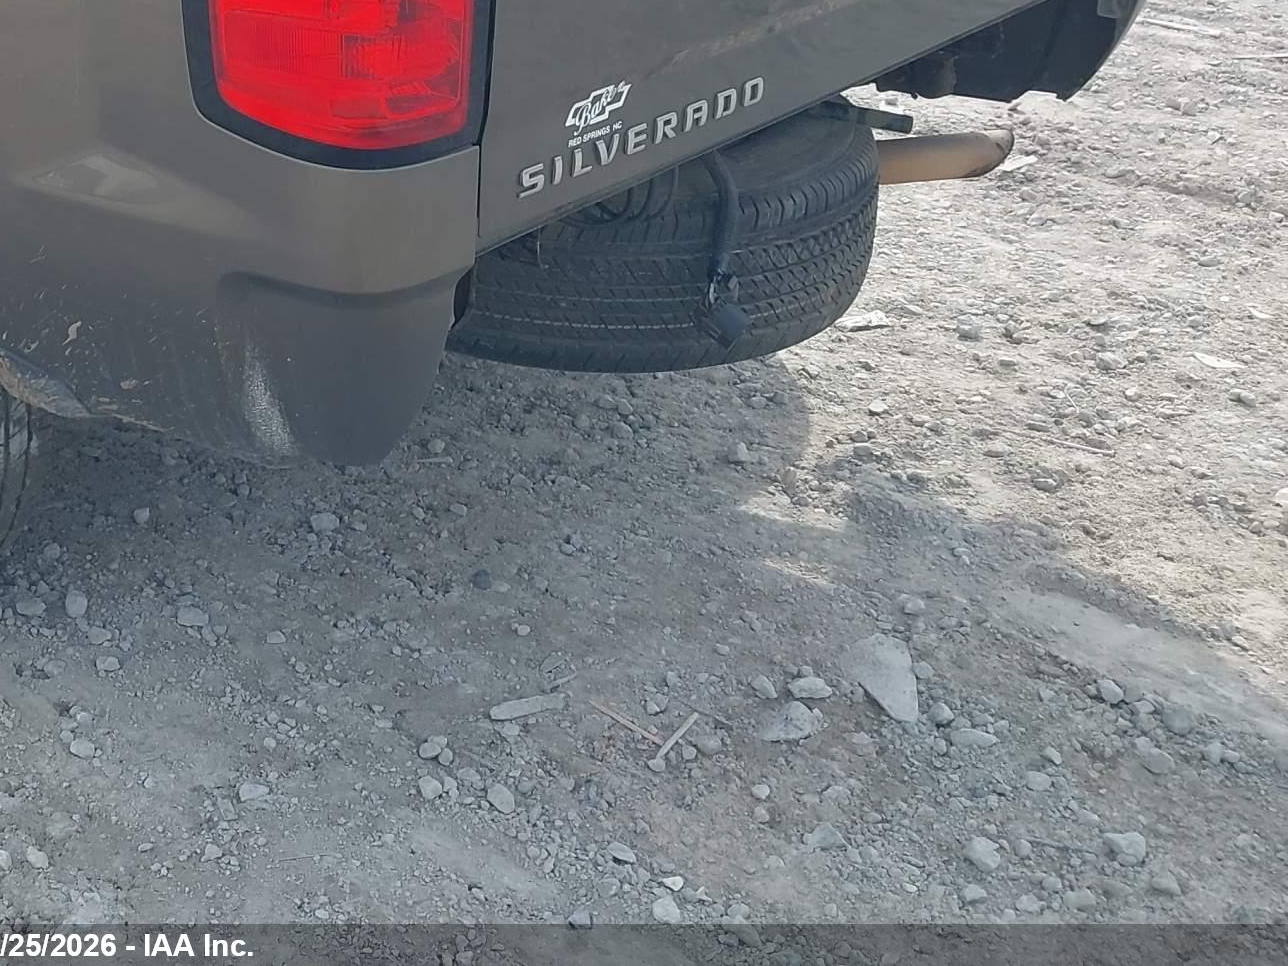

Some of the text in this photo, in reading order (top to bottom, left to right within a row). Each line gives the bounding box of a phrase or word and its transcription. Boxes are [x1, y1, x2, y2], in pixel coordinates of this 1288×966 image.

[518, 76, 764, 198] SILVERADO
[567, 120, 623, 148] RED SPRINGS NC
